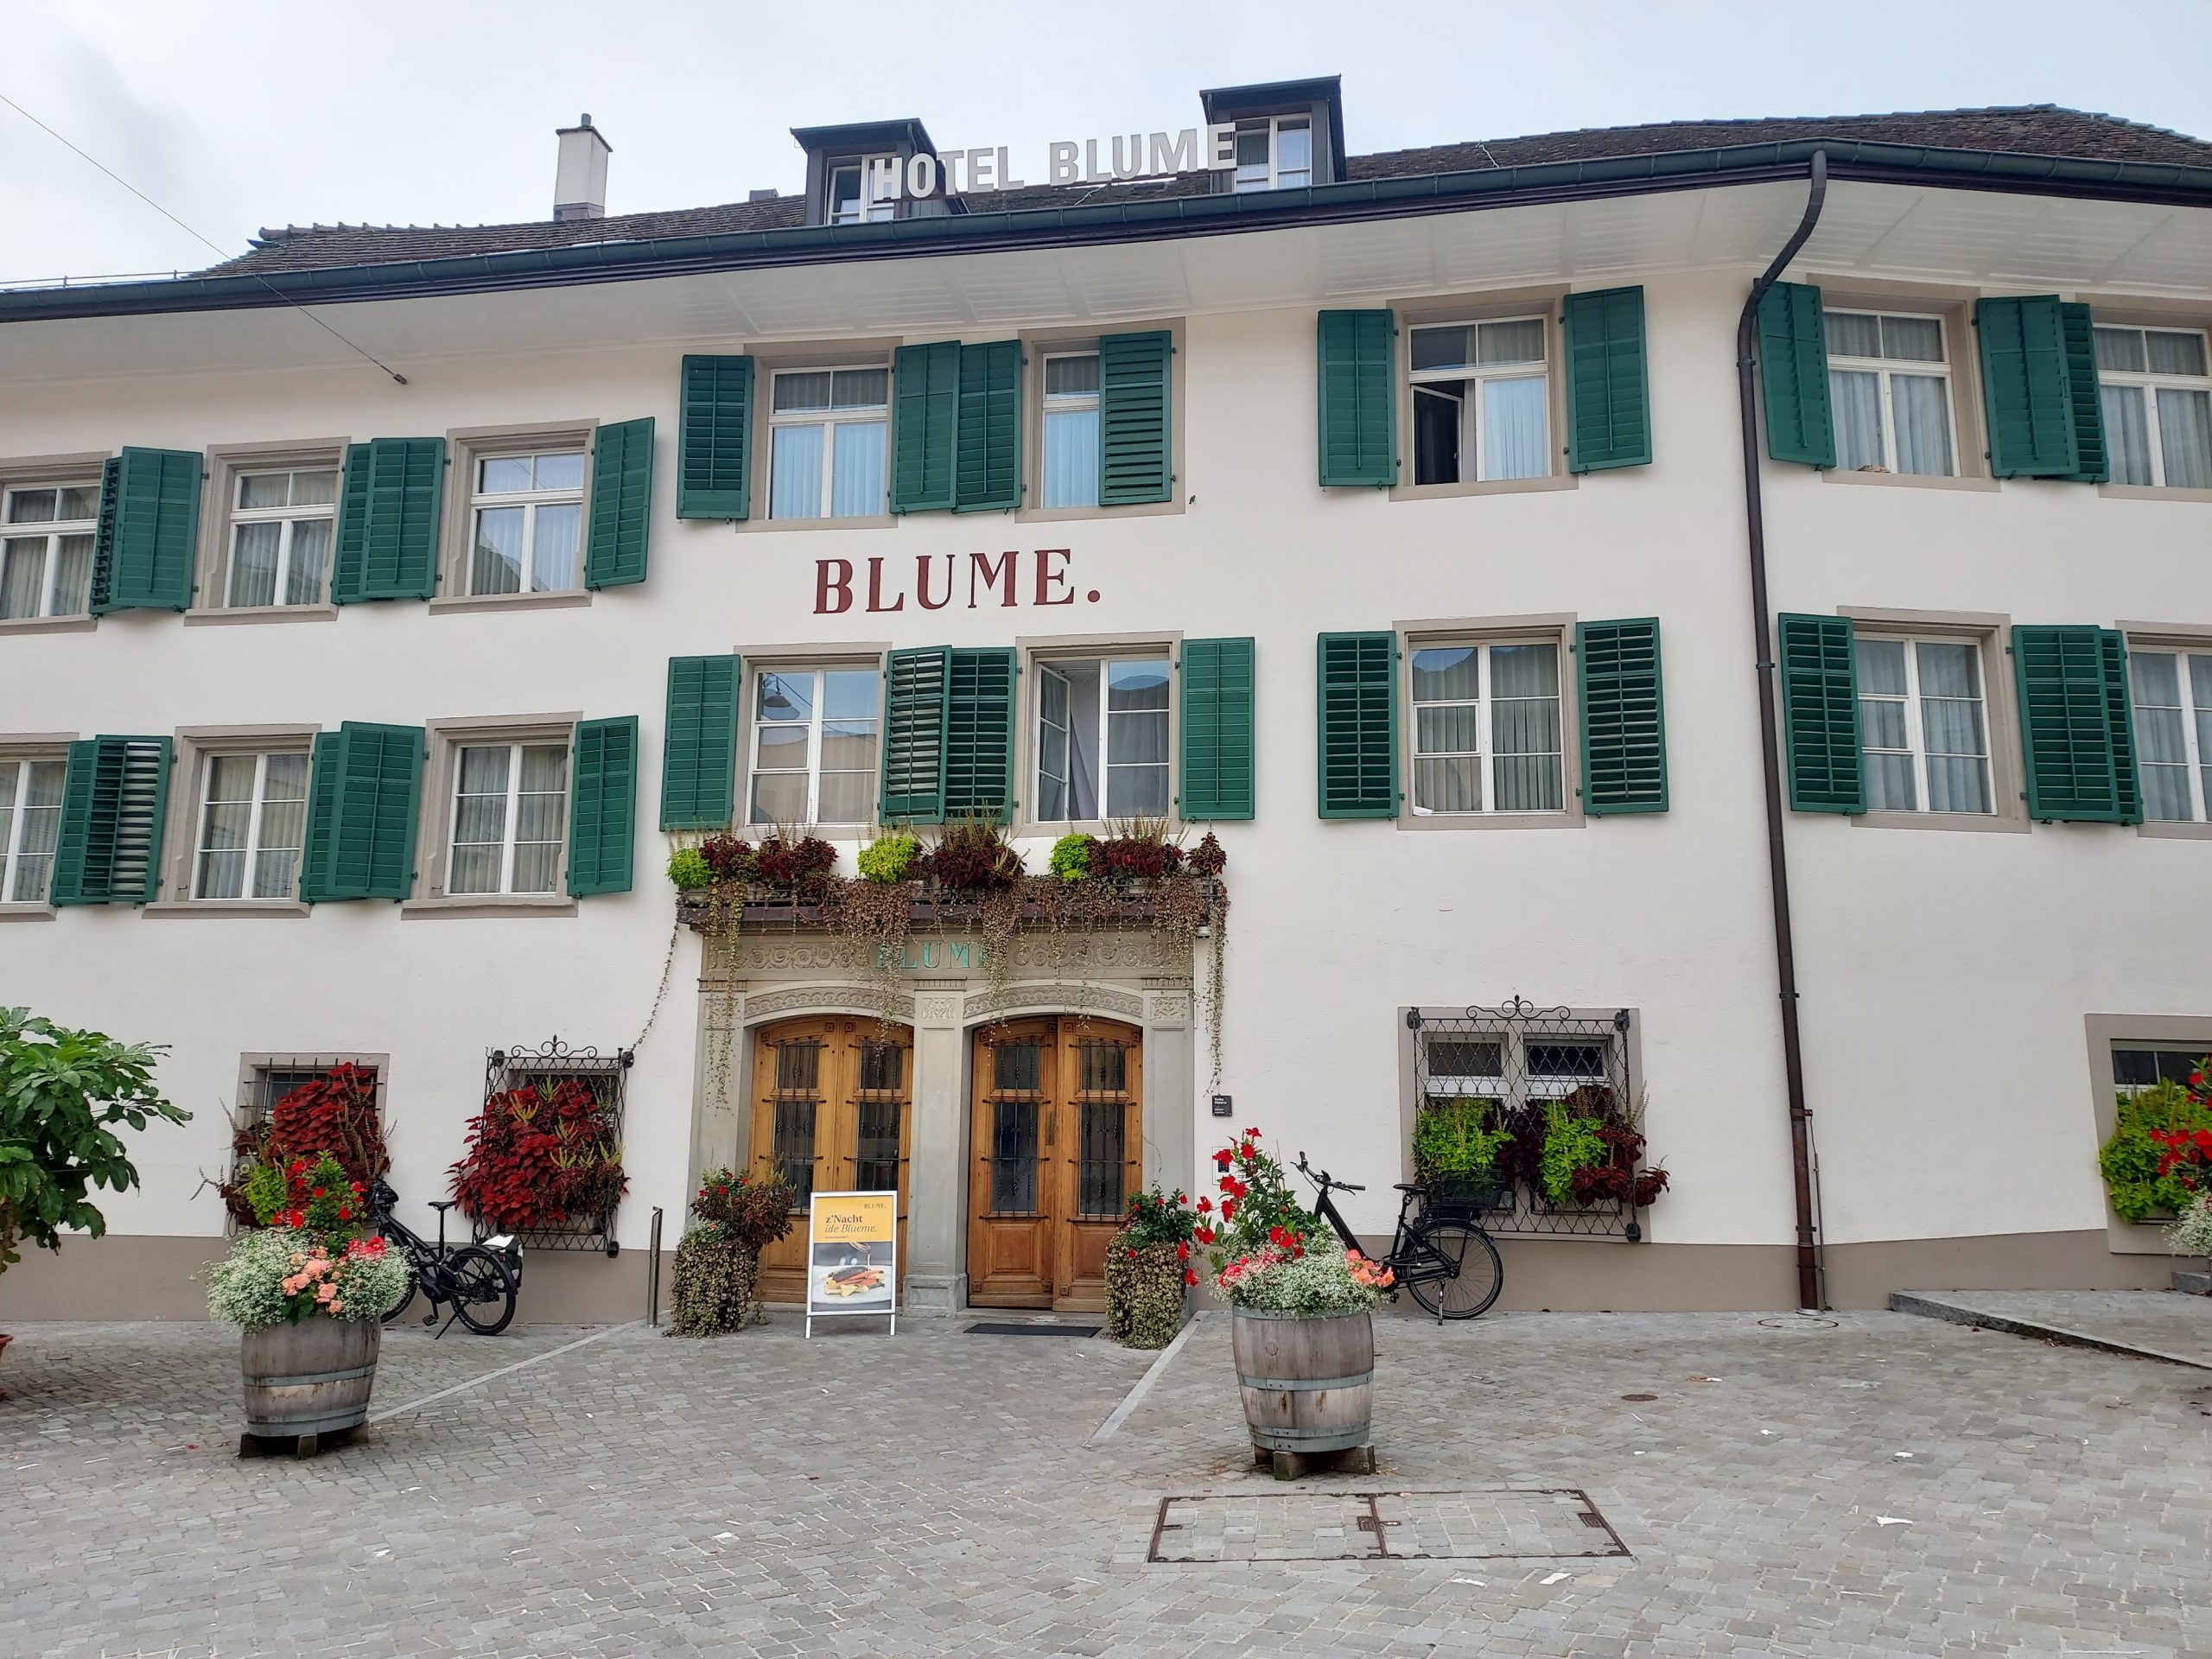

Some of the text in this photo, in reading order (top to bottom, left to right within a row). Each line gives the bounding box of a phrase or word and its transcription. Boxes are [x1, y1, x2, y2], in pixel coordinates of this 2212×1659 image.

[874, 123, 1237, 201] HOTEL BLUME
[812, 549, 1102, 614] BLUME.
[824, 1224, 878, 1233] ide Blueme.
